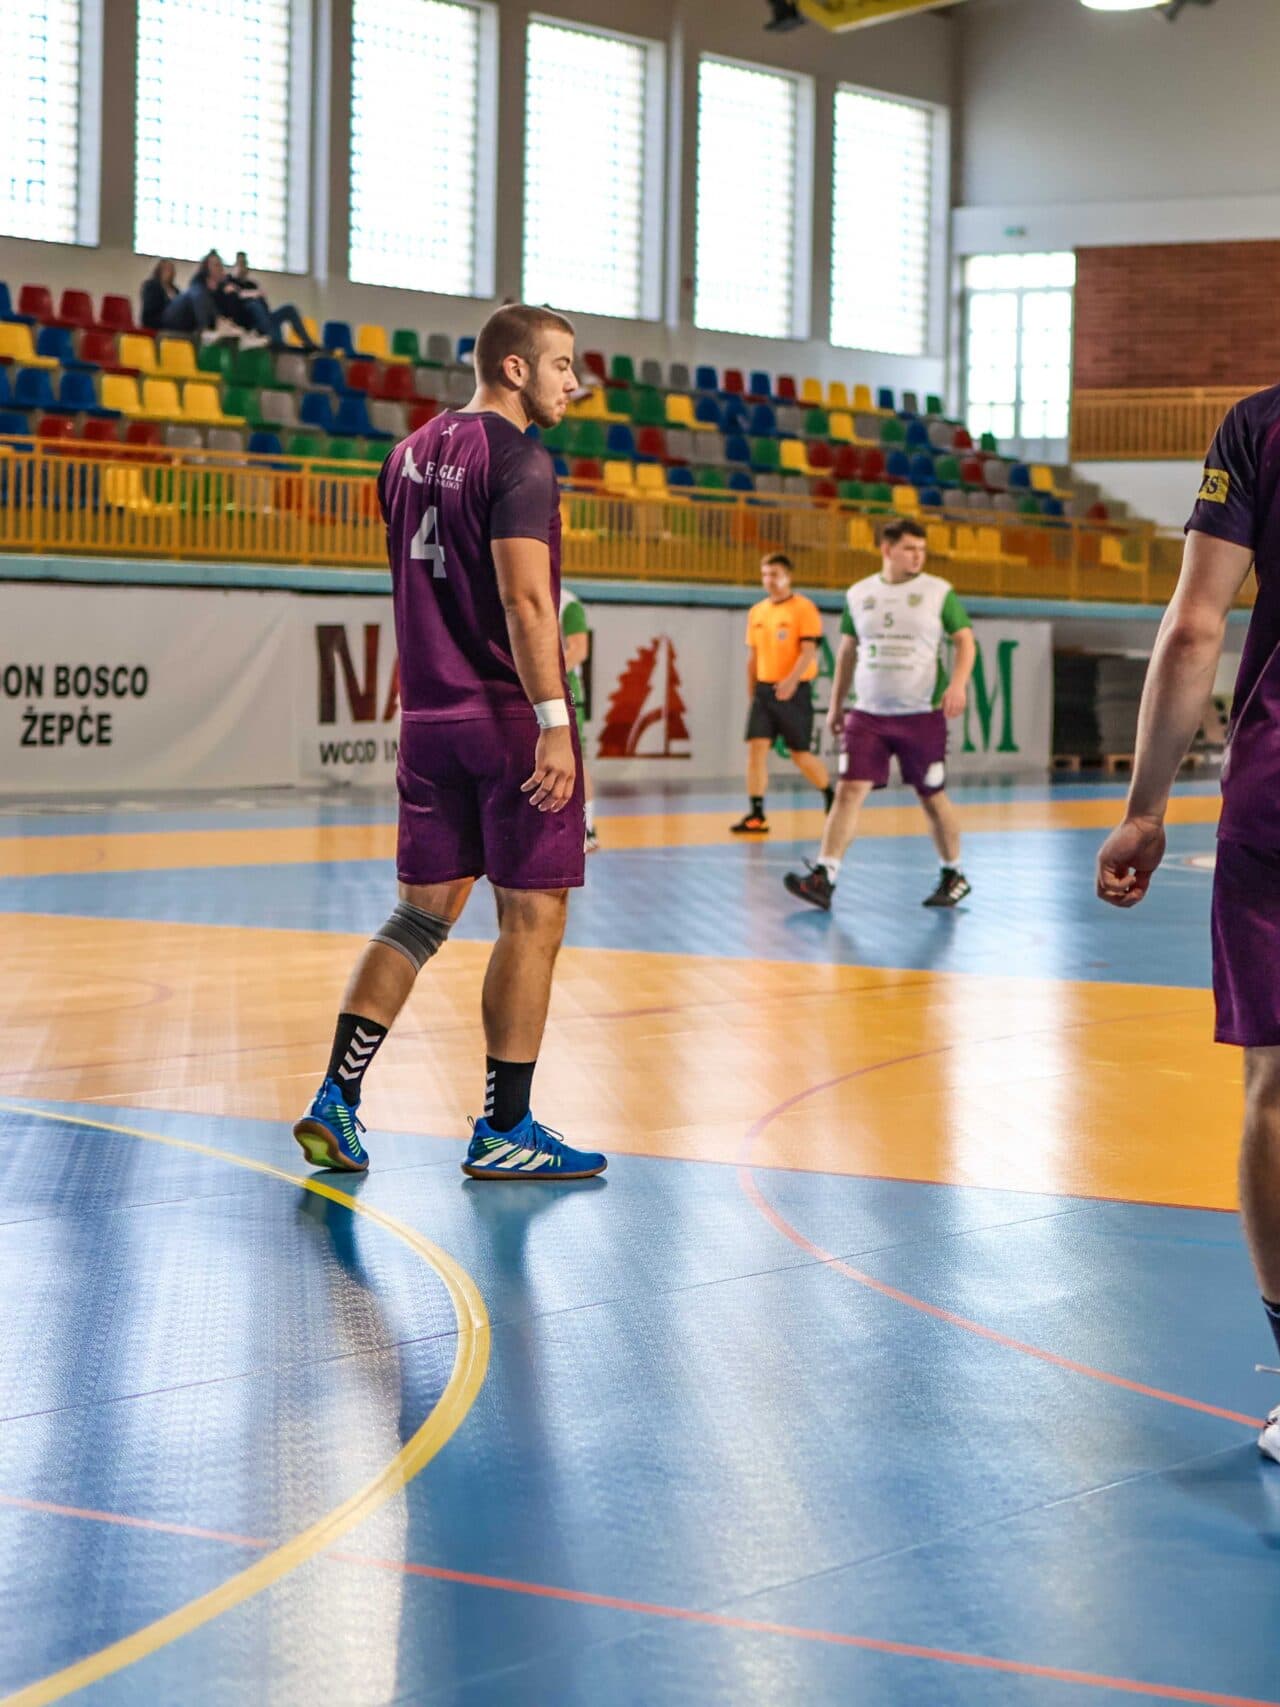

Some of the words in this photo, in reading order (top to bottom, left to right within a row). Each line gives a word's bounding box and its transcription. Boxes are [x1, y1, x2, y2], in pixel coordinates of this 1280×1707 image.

[426, 461, 466, 482] EGLE
[410, 505, 447, 578] 4
[883, 611, 894, 628] 5
[0, 664, 43, 698] ON
[54, 665, 148, 698] BOSCO
[20, 705, 112, 746] ŽEPČE
[319, 739, 377, 765] WOOD
